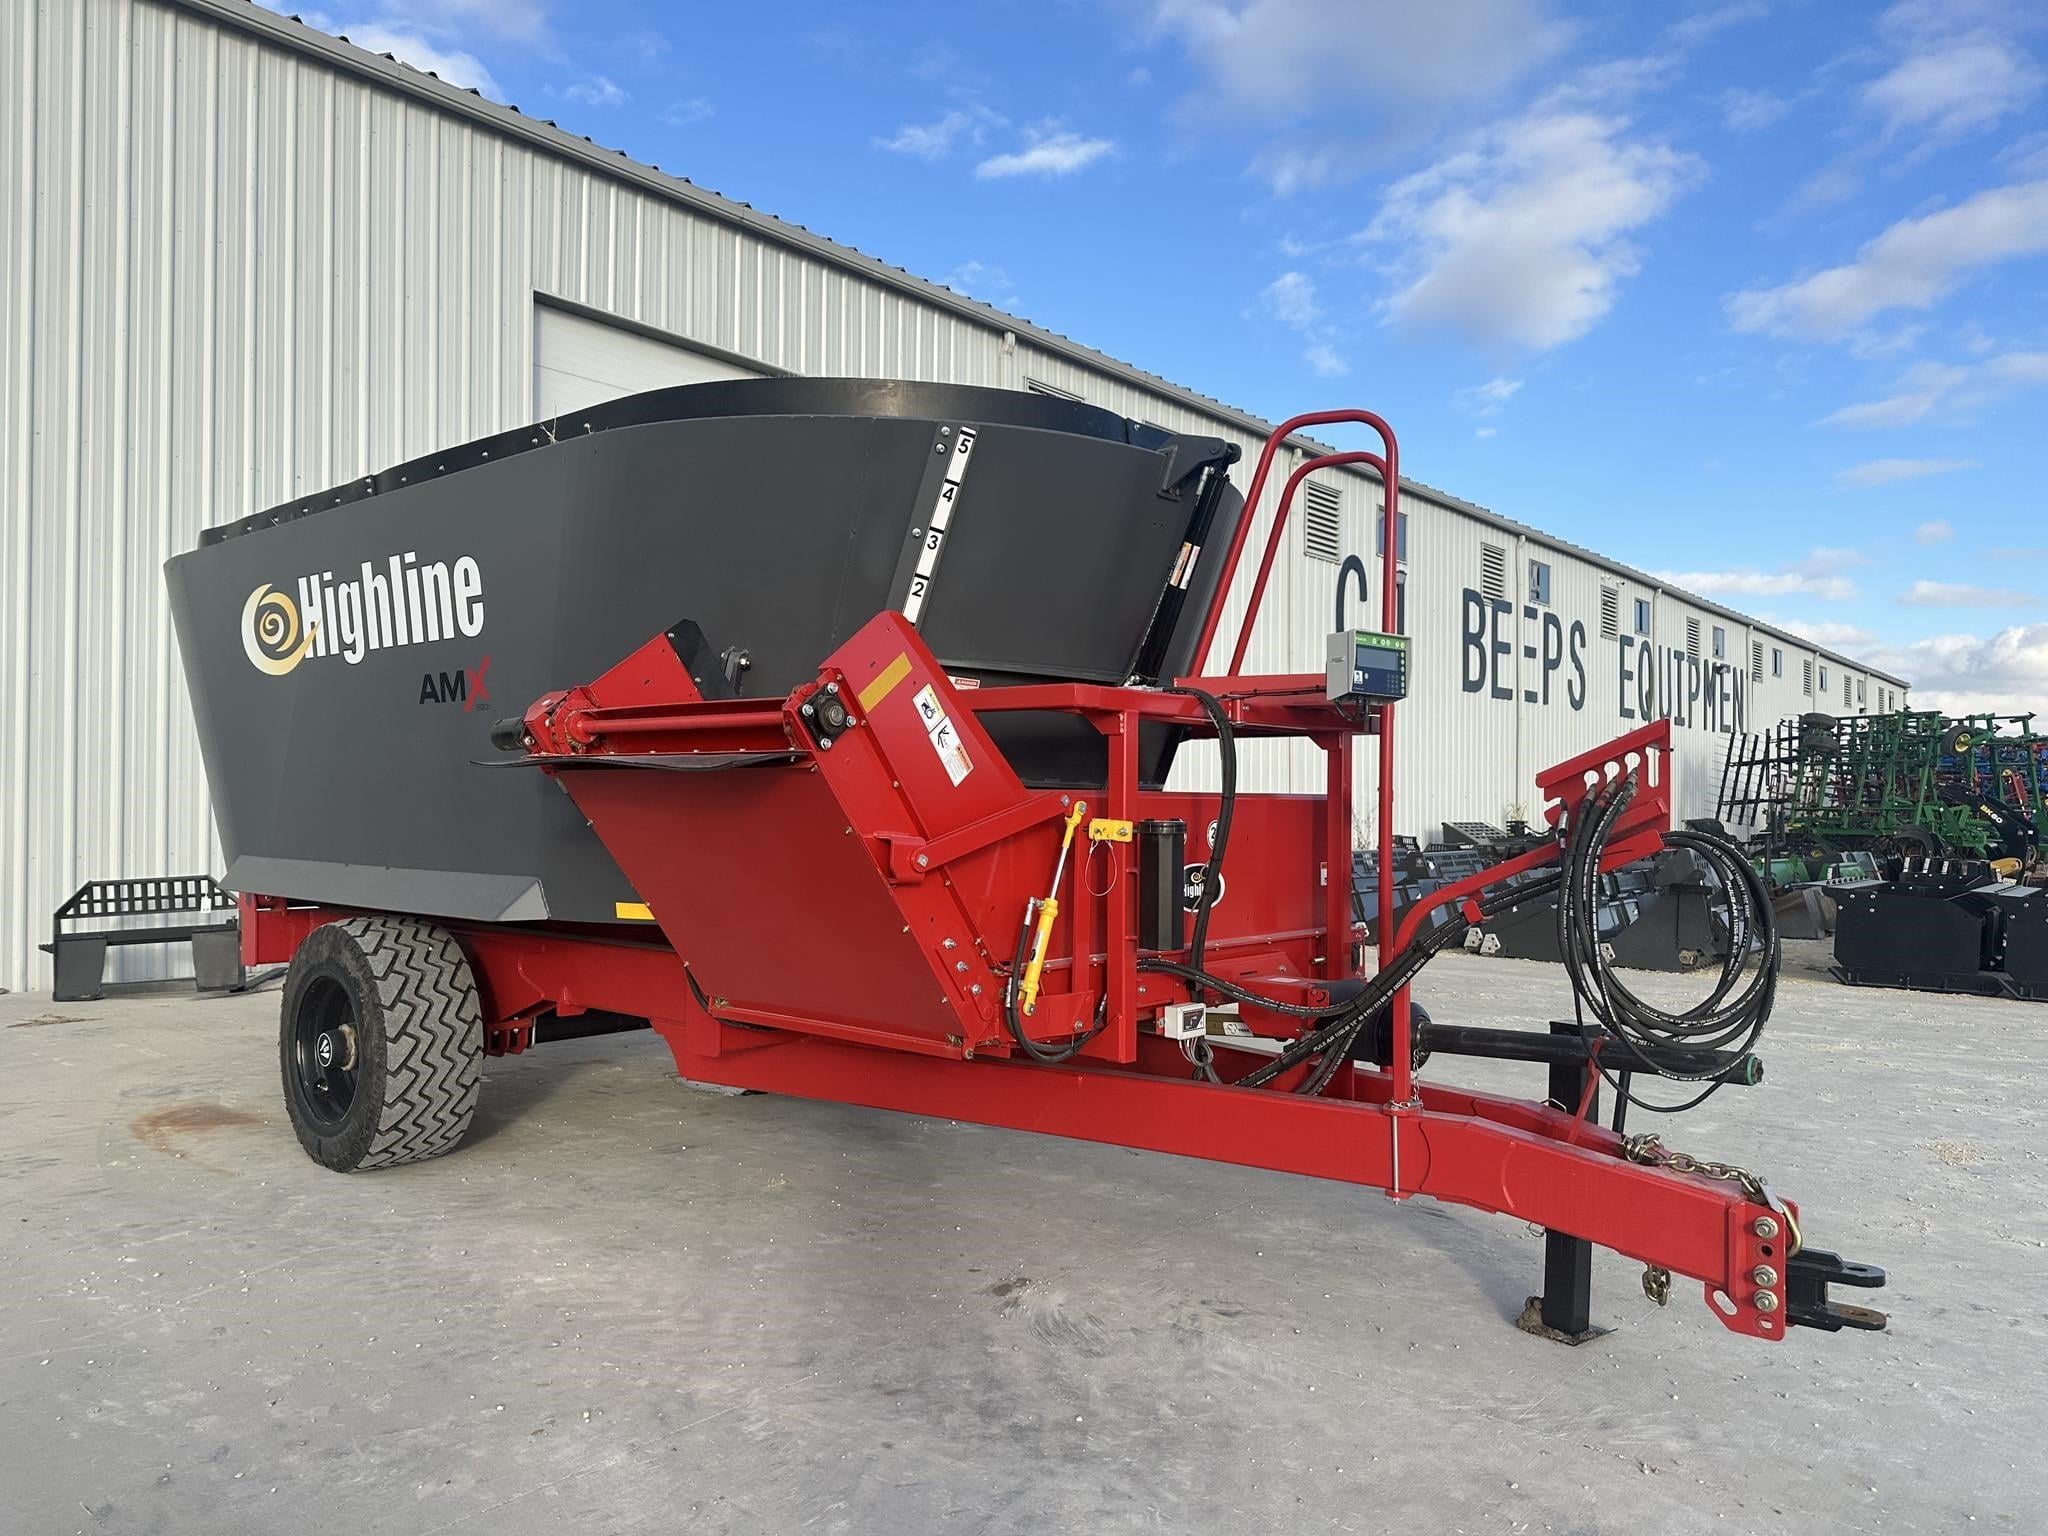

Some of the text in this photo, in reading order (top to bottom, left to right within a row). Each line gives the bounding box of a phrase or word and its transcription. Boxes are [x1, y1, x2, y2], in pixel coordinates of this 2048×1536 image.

[958, 439, 971, 454] 5
[942, 487, 955, 502] 4
[927, 535, 939, 550] 3
[911, 581, 925, 597] 2
[297, 551, 484, 665] Highline
[1463, 587, 1586, 711] BEEPS
[1620, 634, 1744, 736] EQUIPMEN
[419, 655, 490, 713] AMX
[1183, 882, 1204, 899] Highli
[1725, 880, 1738, 917] PULSAR
